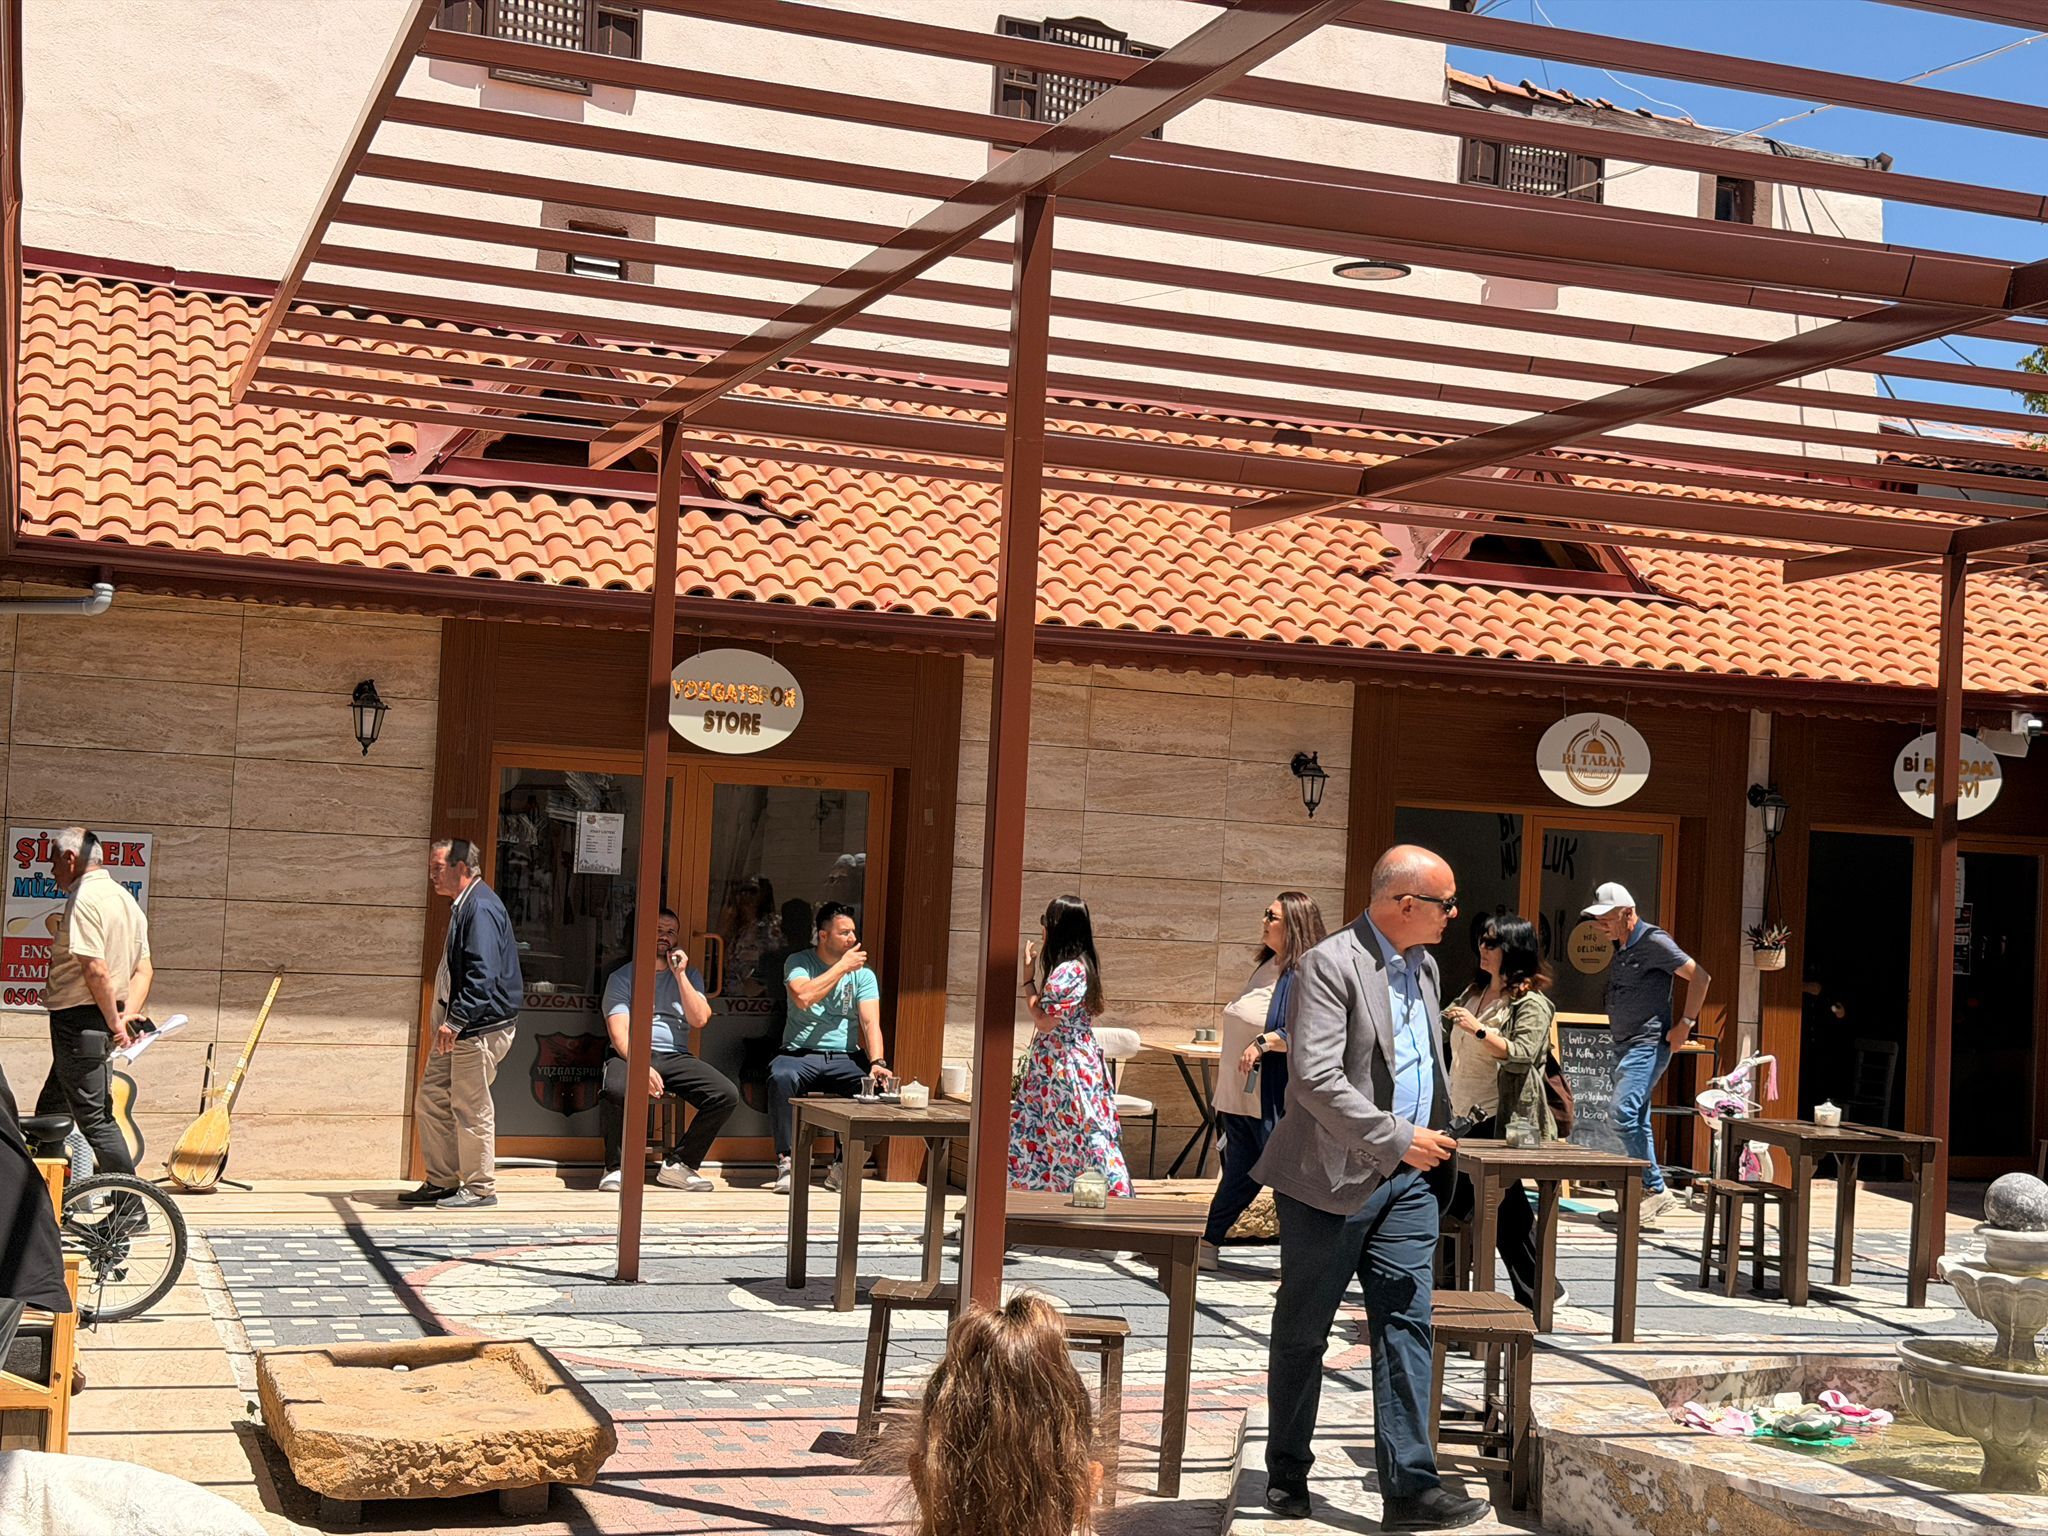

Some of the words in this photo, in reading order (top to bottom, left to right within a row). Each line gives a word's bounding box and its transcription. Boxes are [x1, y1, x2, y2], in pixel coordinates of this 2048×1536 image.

[703, 710, 761, 736] STORE
[1562, 751, 1576, 765] Bİ
[1581, 754, 1626, 768] TABAK
[1903, 752, 1919, 772] Bİ
[1924, 757, 1994, 777] BDAK
[14, 832, 145, 869] ŞİEK
[7, 962, 50, 979] TAMİ
